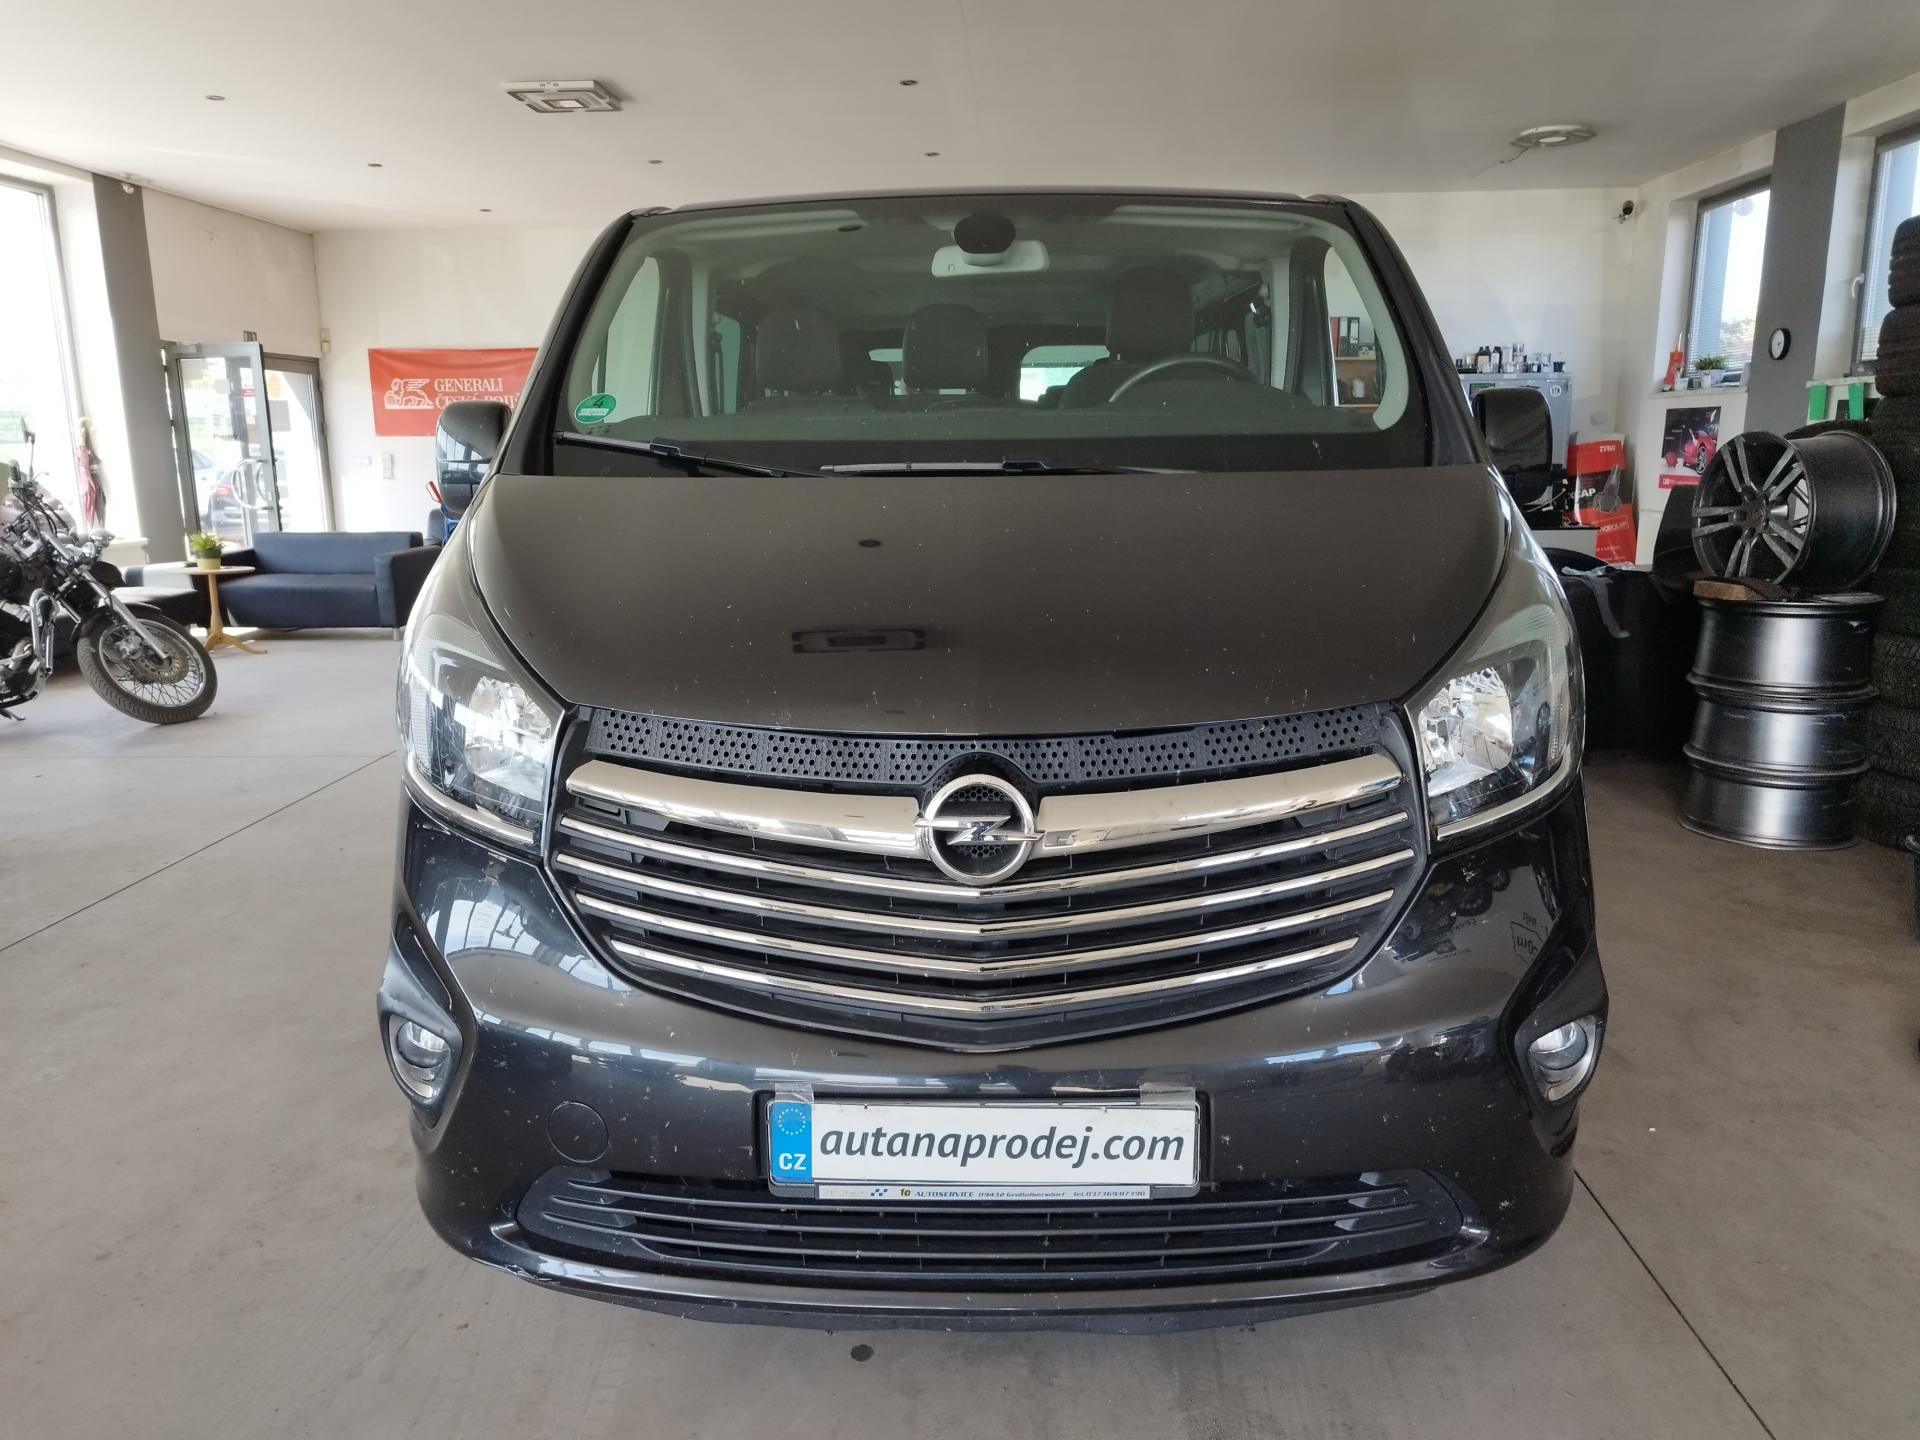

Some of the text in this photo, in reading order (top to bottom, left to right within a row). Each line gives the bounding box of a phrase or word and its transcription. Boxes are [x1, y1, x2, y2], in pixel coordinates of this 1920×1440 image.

[434, 378, 503, 392] GENERALI
[819, 1125, 1185, 1169] autanaprodej.com
[778, 1152, 807, 1172] CZ
